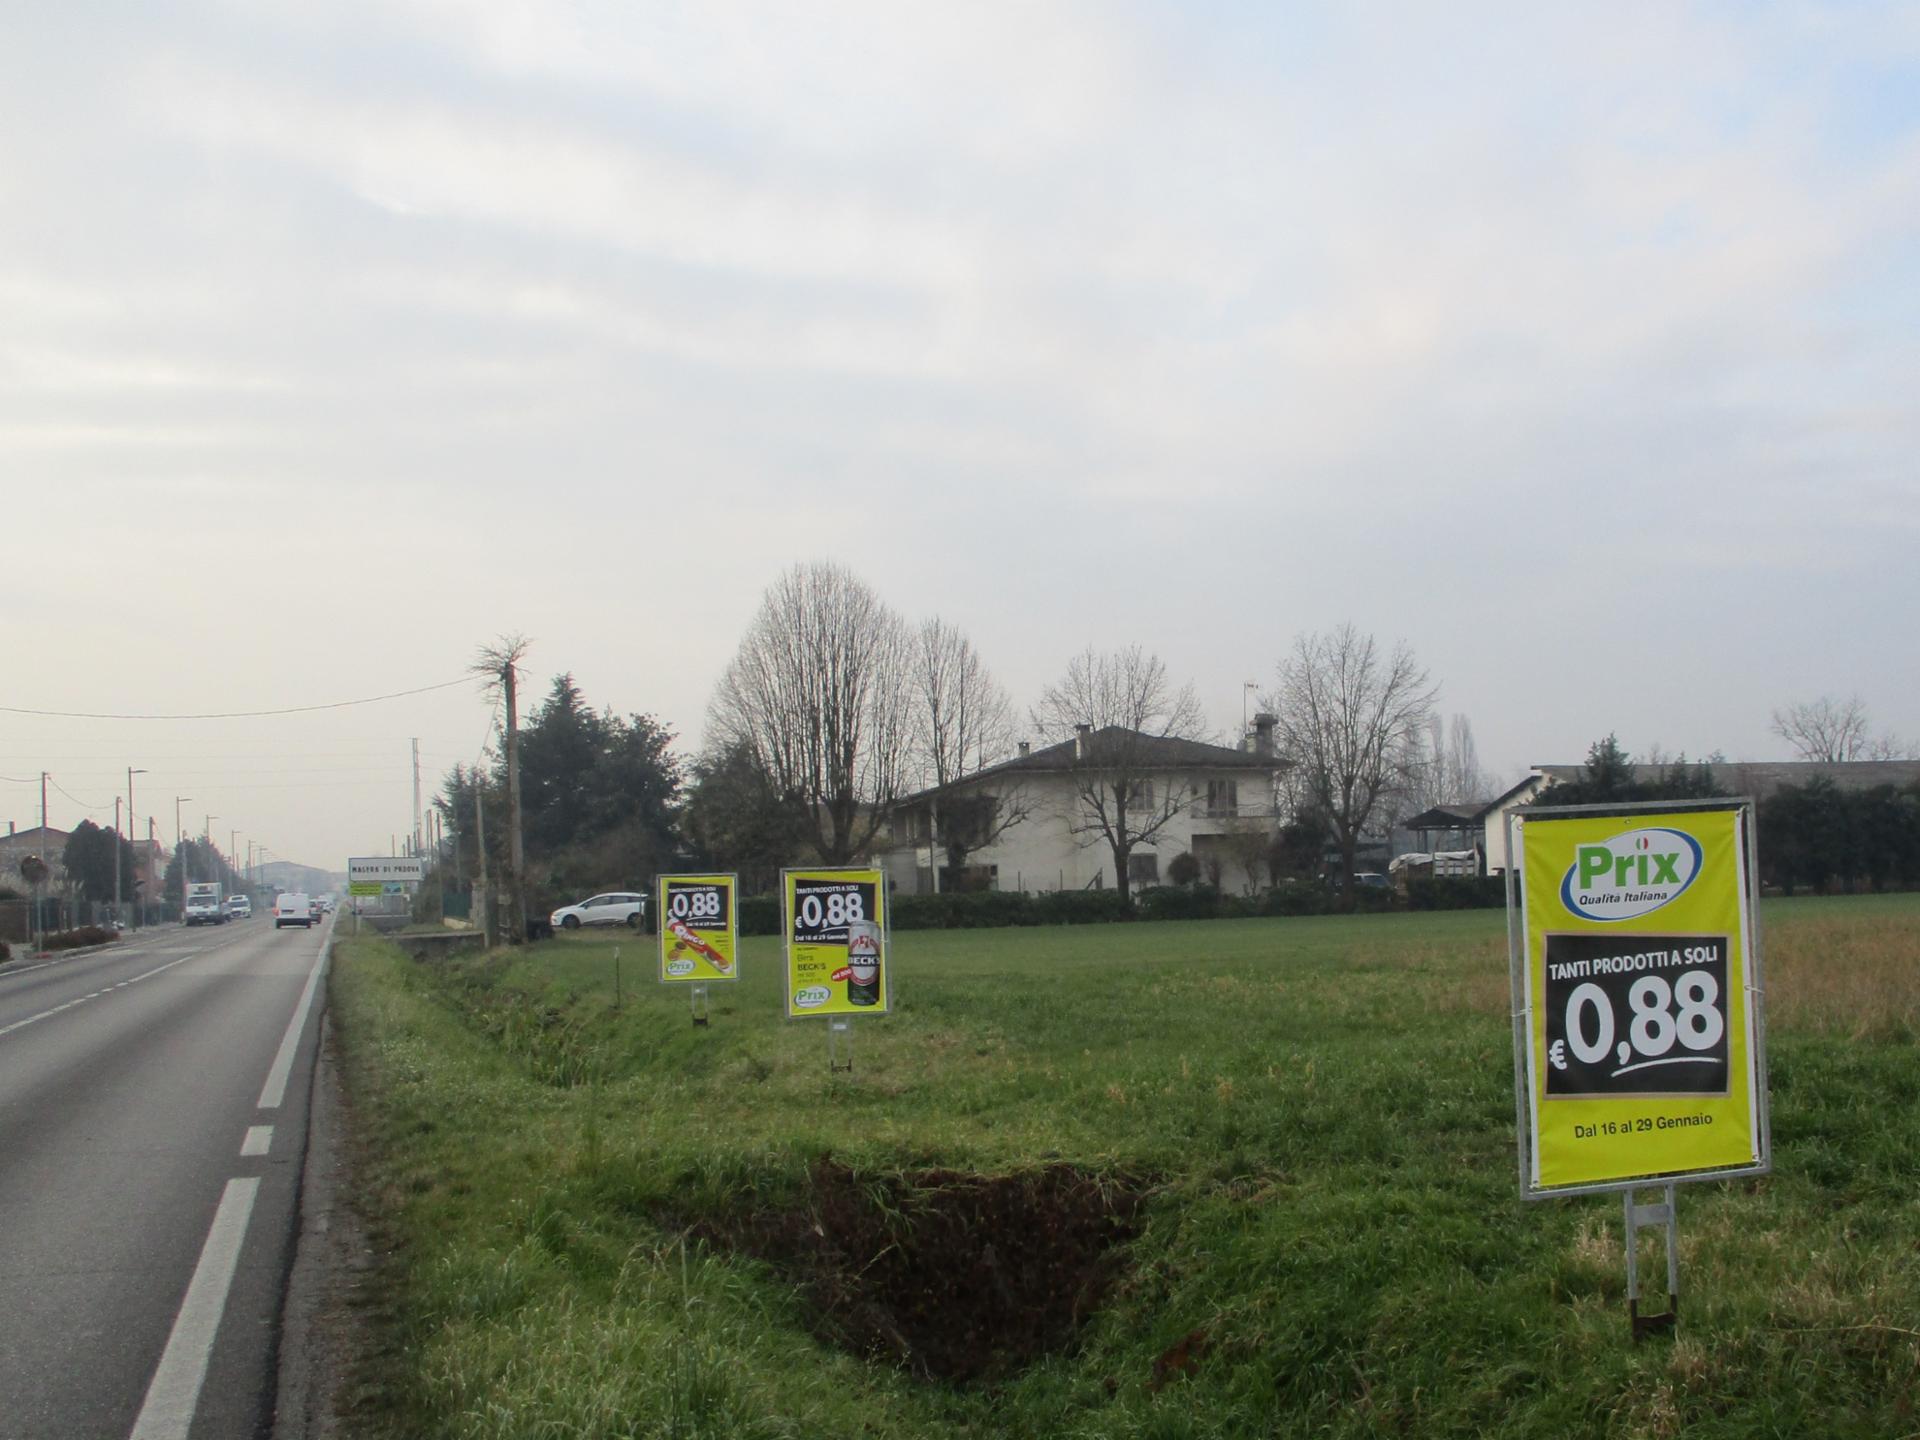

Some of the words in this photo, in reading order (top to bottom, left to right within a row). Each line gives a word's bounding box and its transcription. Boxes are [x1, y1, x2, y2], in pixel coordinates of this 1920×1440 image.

[1578, 837, 1682, 890] Prix
[1624, 890, 1668, 903] Italiana
[1549, 959, 1591, 981] TANTI
[1593, 951, 1668, 975] PRODOTTI
[1671, 950, 1682, 965] A
[1684, 945, 1718, 965] SOLI
[798, 988, 825, 1001] Prix
[1574, 1124, 1597, 1139] Dal
[1601, 1121, 1617, 1136] 16
[1621, 1119, 1633, 1134] al
[1636, 1118, 1653, 1132] 29
[1656, 1112, 1713, 1130] Gennaio
